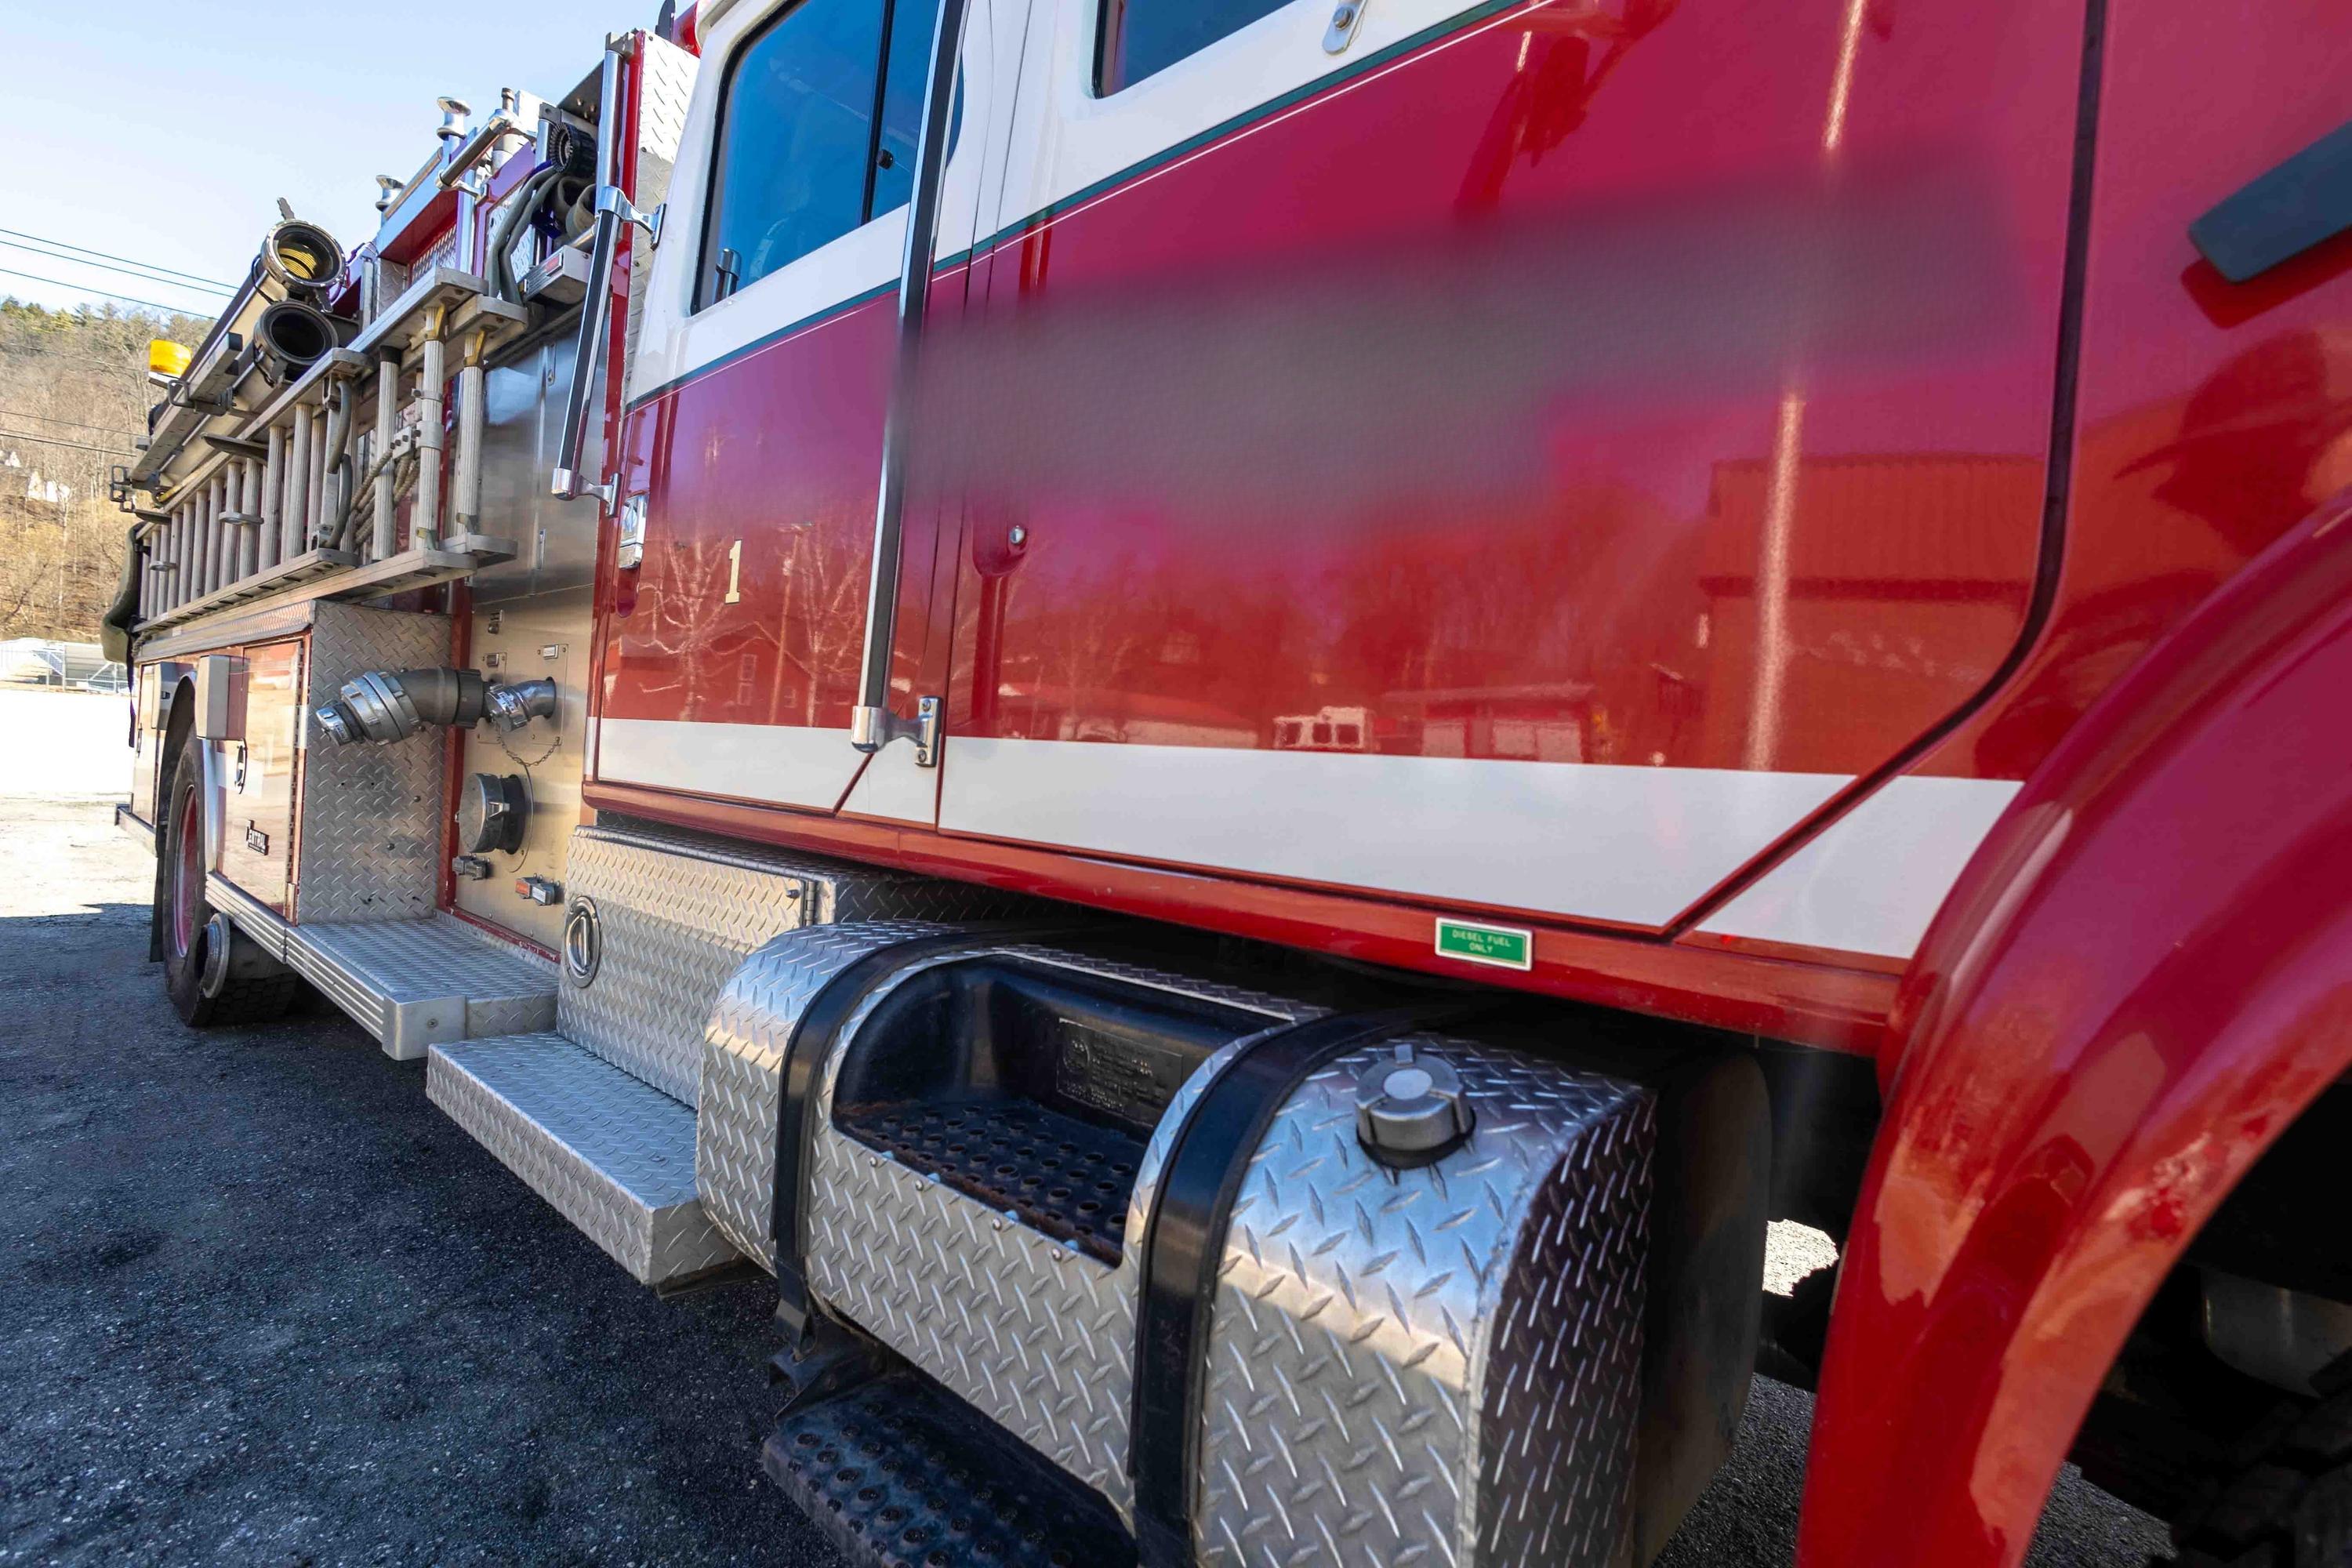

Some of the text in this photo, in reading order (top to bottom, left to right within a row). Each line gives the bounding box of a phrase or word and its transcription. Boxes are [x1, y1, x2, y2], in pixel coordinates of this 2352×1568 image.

[725, 539, 742, 604] 1
[1452, 929, 1512, 947] DIESEL FUEL
[1468, 942, 1494, 953] ONLY
